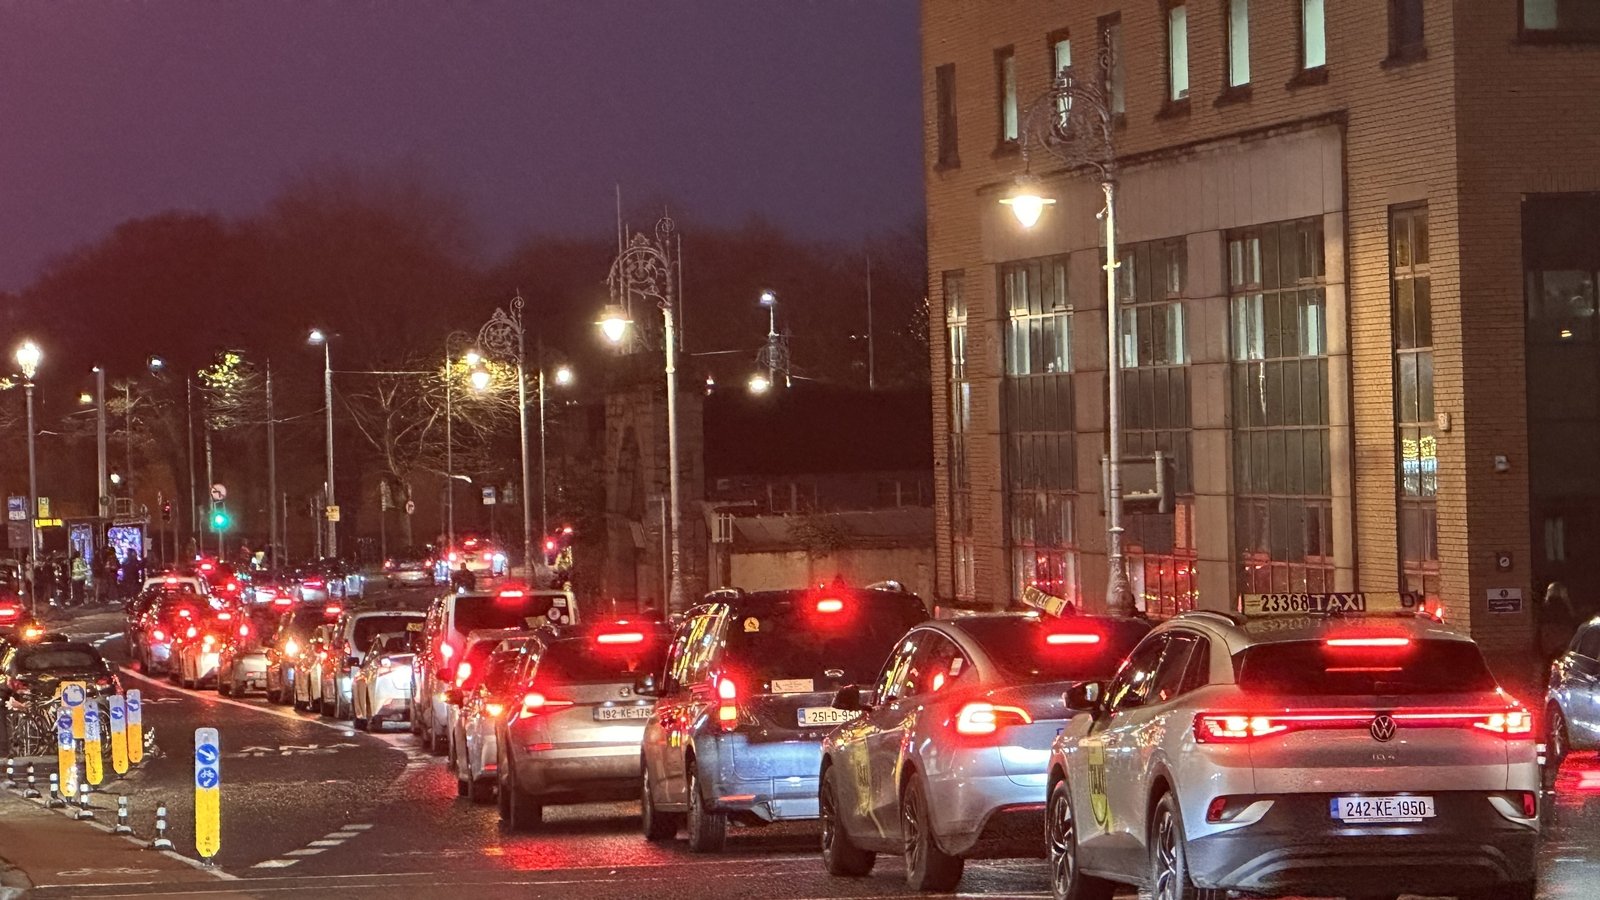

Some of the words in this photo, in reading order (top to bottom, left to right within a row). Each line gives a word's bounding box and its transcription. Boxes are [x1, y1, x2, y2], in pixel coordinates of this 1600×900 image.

[1261, 594, 1309, 612] 23368
[1311, 594, 1365, 612] TAXI
[1346, 801, 1426, 817] 242-KE-1950
